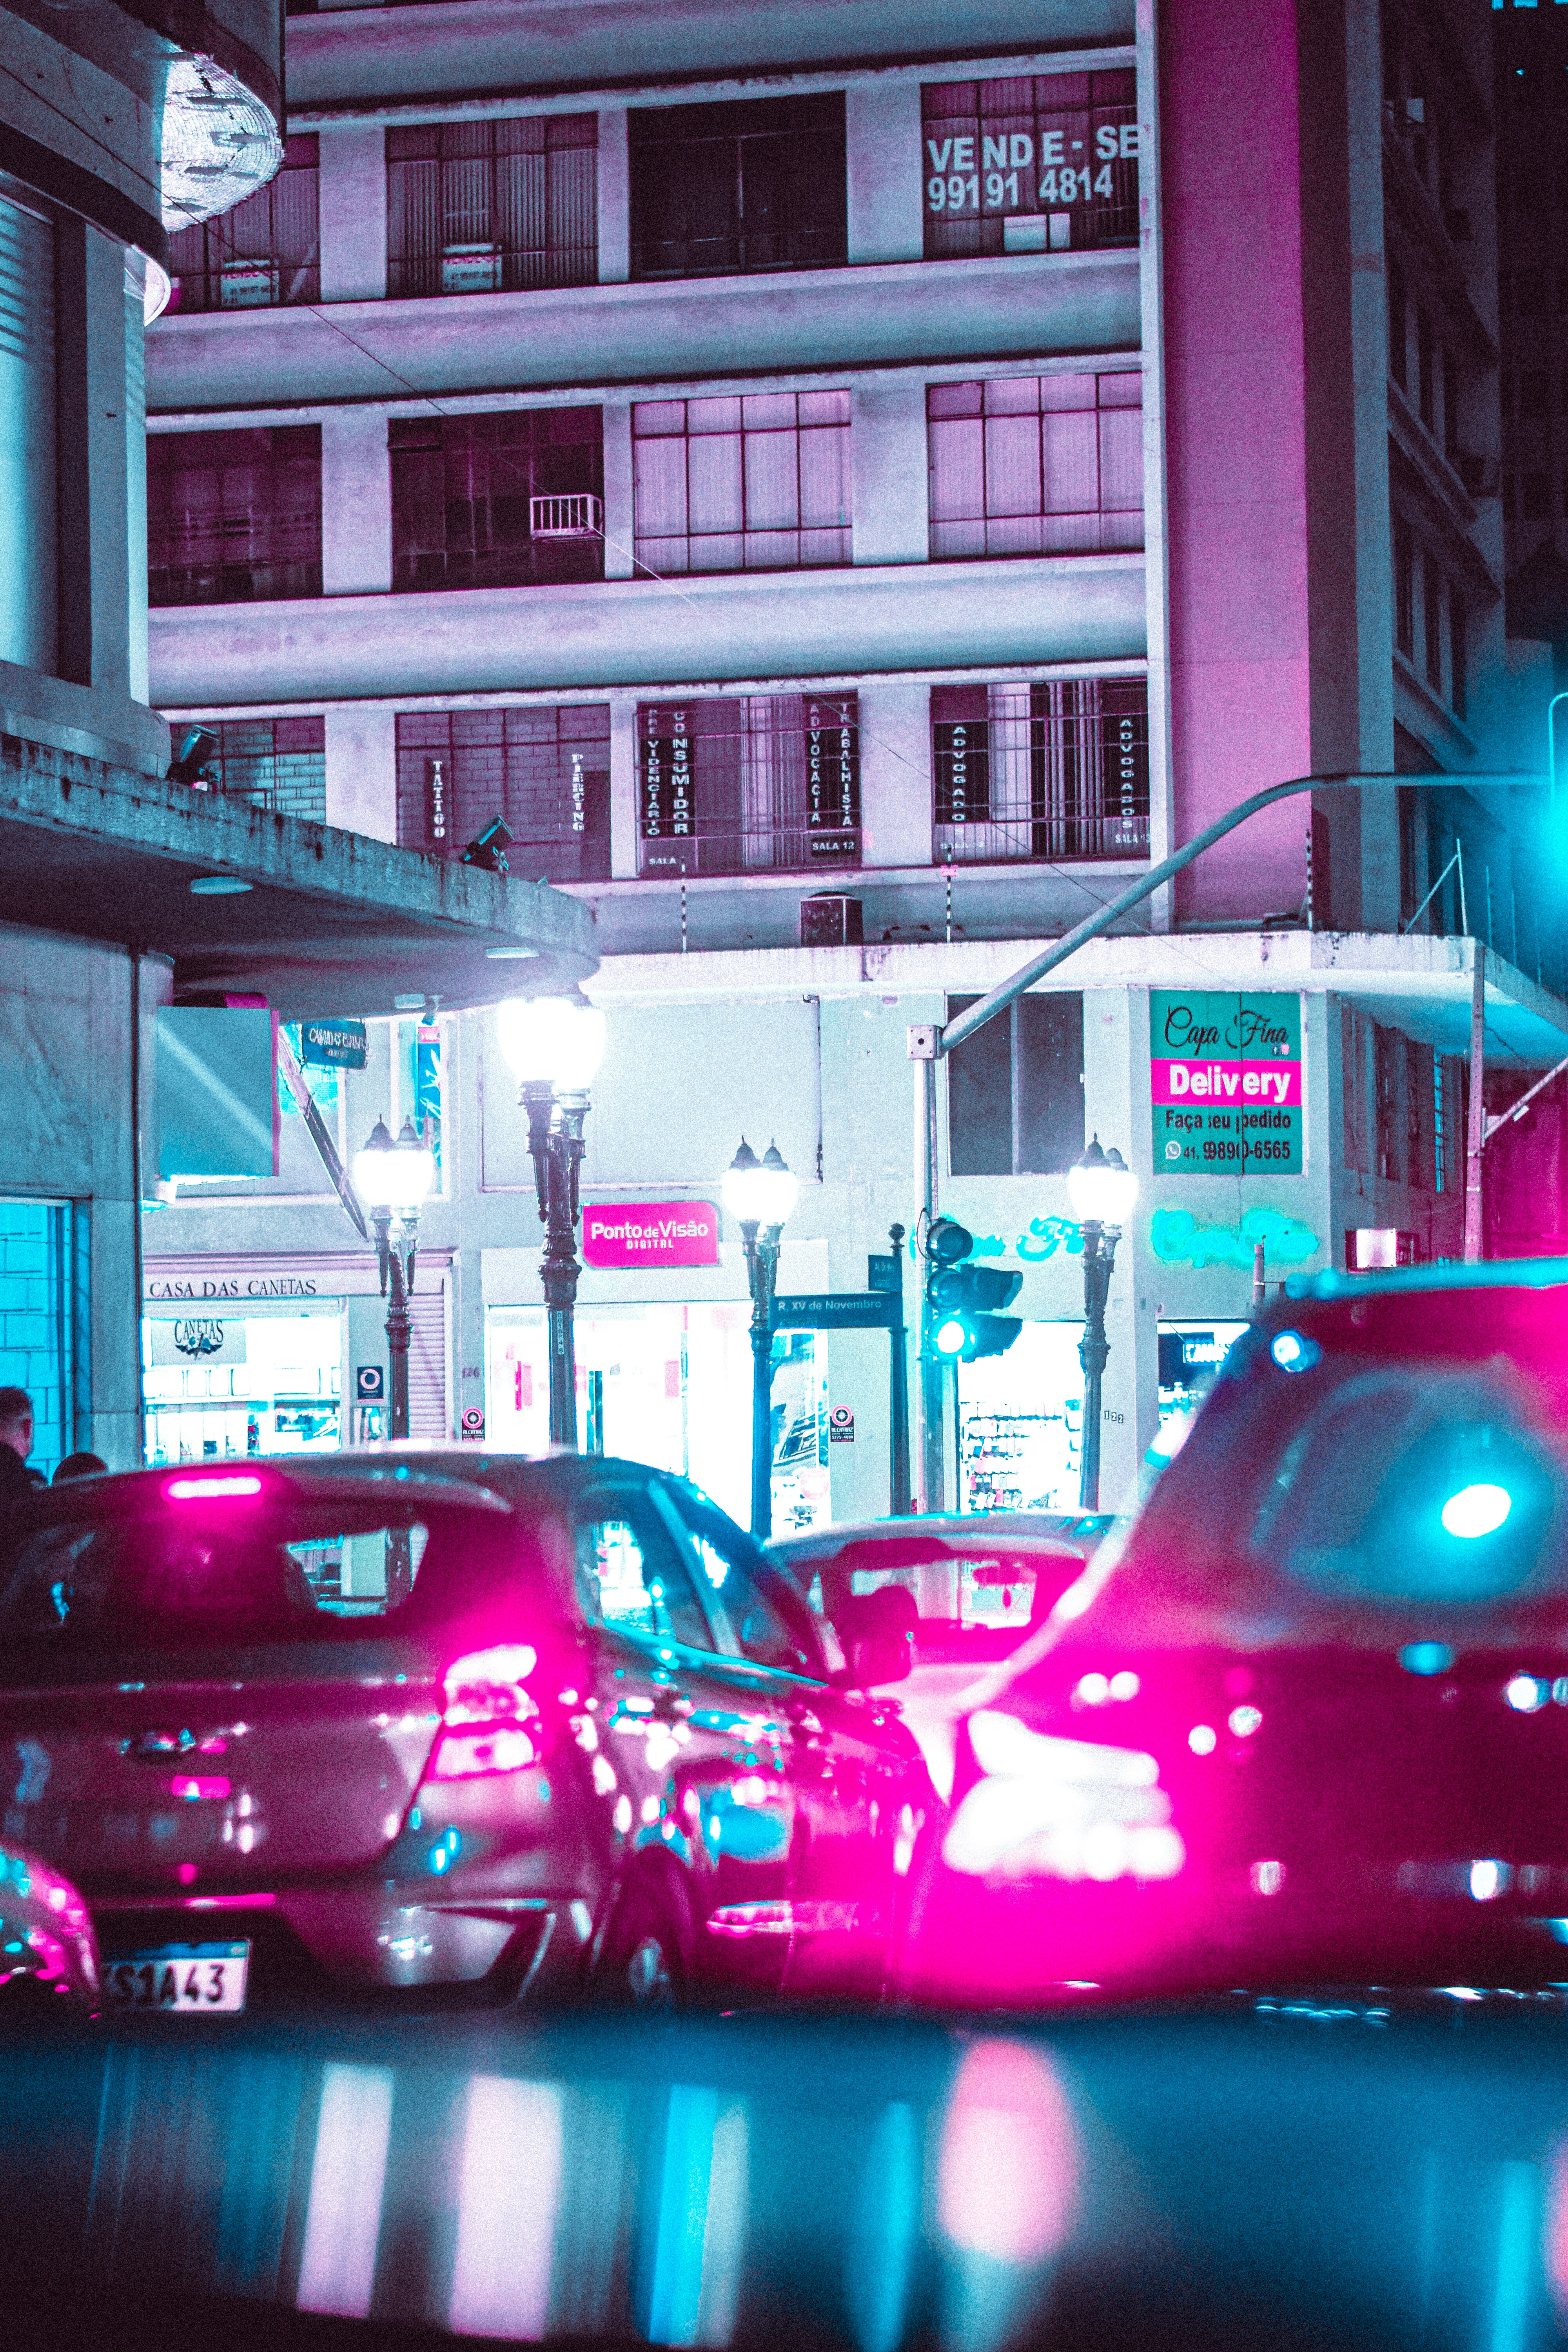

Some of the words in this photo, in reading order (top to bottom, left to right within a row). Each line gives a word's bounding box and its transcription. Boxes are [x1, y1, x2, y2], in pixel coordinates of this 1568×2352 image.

[927, 172, 1019, 211] 99191
[1039, 164, 1114, 203] 4814
[671, 711, 690, 834] CONSUMIDOR
[809, 705, 821, 823] ADVOCACIA
[840, 703, 852, 826] TRABALHISTA
[1119, 719, 1135, 828] ADVOGADOS
[433, 760, 445, 838] TATTOO
[812, 842, 839, 850] SALA
[842, 841, 855, 850] 12
[1115, 834, 1138, 844] SALA
[1165, 1005, 1220, 1056] Capa
[1225, 1010, 1289, 1049] Fina
[1170, 1063, 1291, 1103] Delivery
[1165, 1109, 1203, 1134] Faça
[1236, 1109, 1291, 1134] pedido
[591, 1222, 642, 1240] Ponto
[659, 1220, 709, 1238] Visão
[627, 1239, 674, 1250] DIGITAL
[149, 1281, 192, 1298] CASA
[203, 1280, 238, 1298] DAS
[247, 1278, 317, 1296] CANETAS
[792, 1300, 806, 1311] XV
[809, 1300, 822, 1310] de
[826, 1299, 882, 1310] Novembro
[174, 1319, 224, 1344] CANETAS
[1105, 1410, 1123, 1423] 122
[103, 1962, 225, 2005] S1A43
